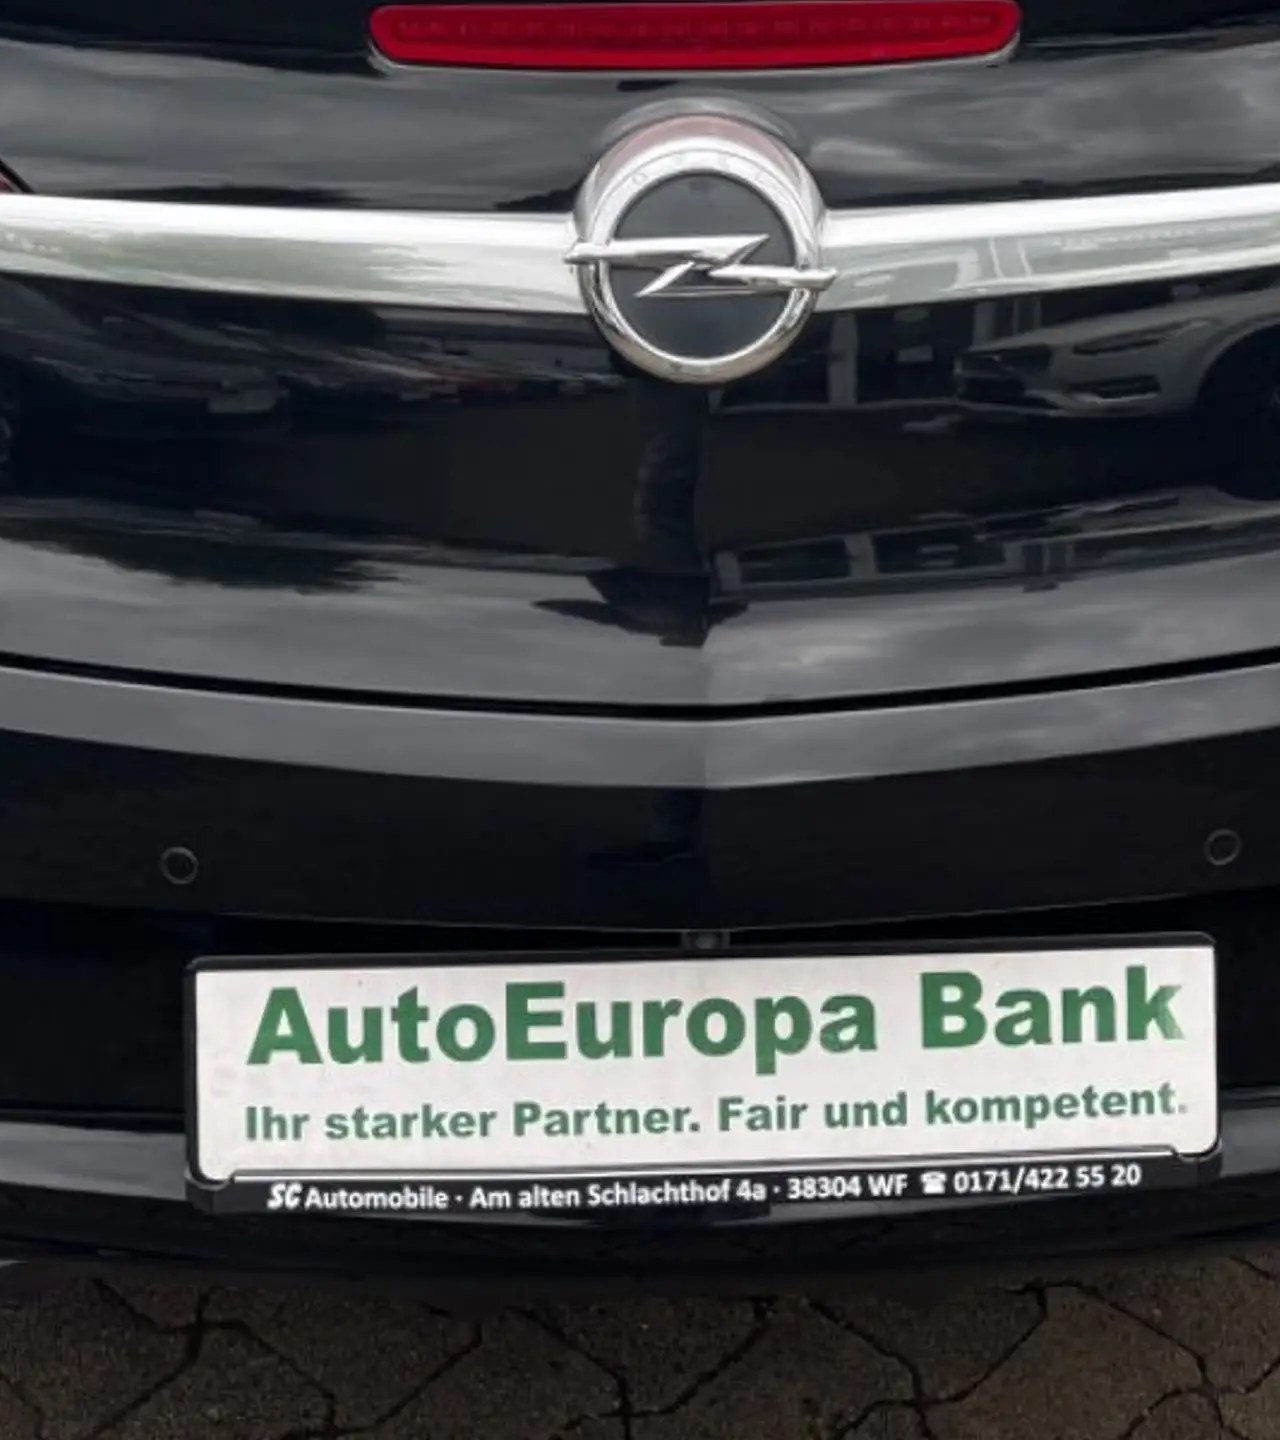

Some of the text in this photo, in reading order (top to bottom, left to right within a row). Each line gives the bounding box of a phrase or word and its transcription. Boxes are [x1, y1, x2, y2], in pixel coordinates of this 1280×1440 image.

[246, 965, 1185, 1076] AutoEuropa Bank
[245, 1082, 1187, 1141] Ihr starker Partner. Fair und kompetent.
[267, 1182, 303, 1209] SC
[304, 1184, 449, 1210] Automobile
[468, 1186, 511, 1208] Am
[519, 1184, 580, 1208] alten
[587, 1178, 731, 1206] Schlachthof
[736, 1179, 767, 1200] 4a
[787, 1175, 862, 1200] 38304
[868, 1173, 908, 1197] WF
[953, 1166, 1069, 1195] 0171/422
[1075, 1165, 1105, 1187] 55
[1111, 1164, 1142, 1187] 20
